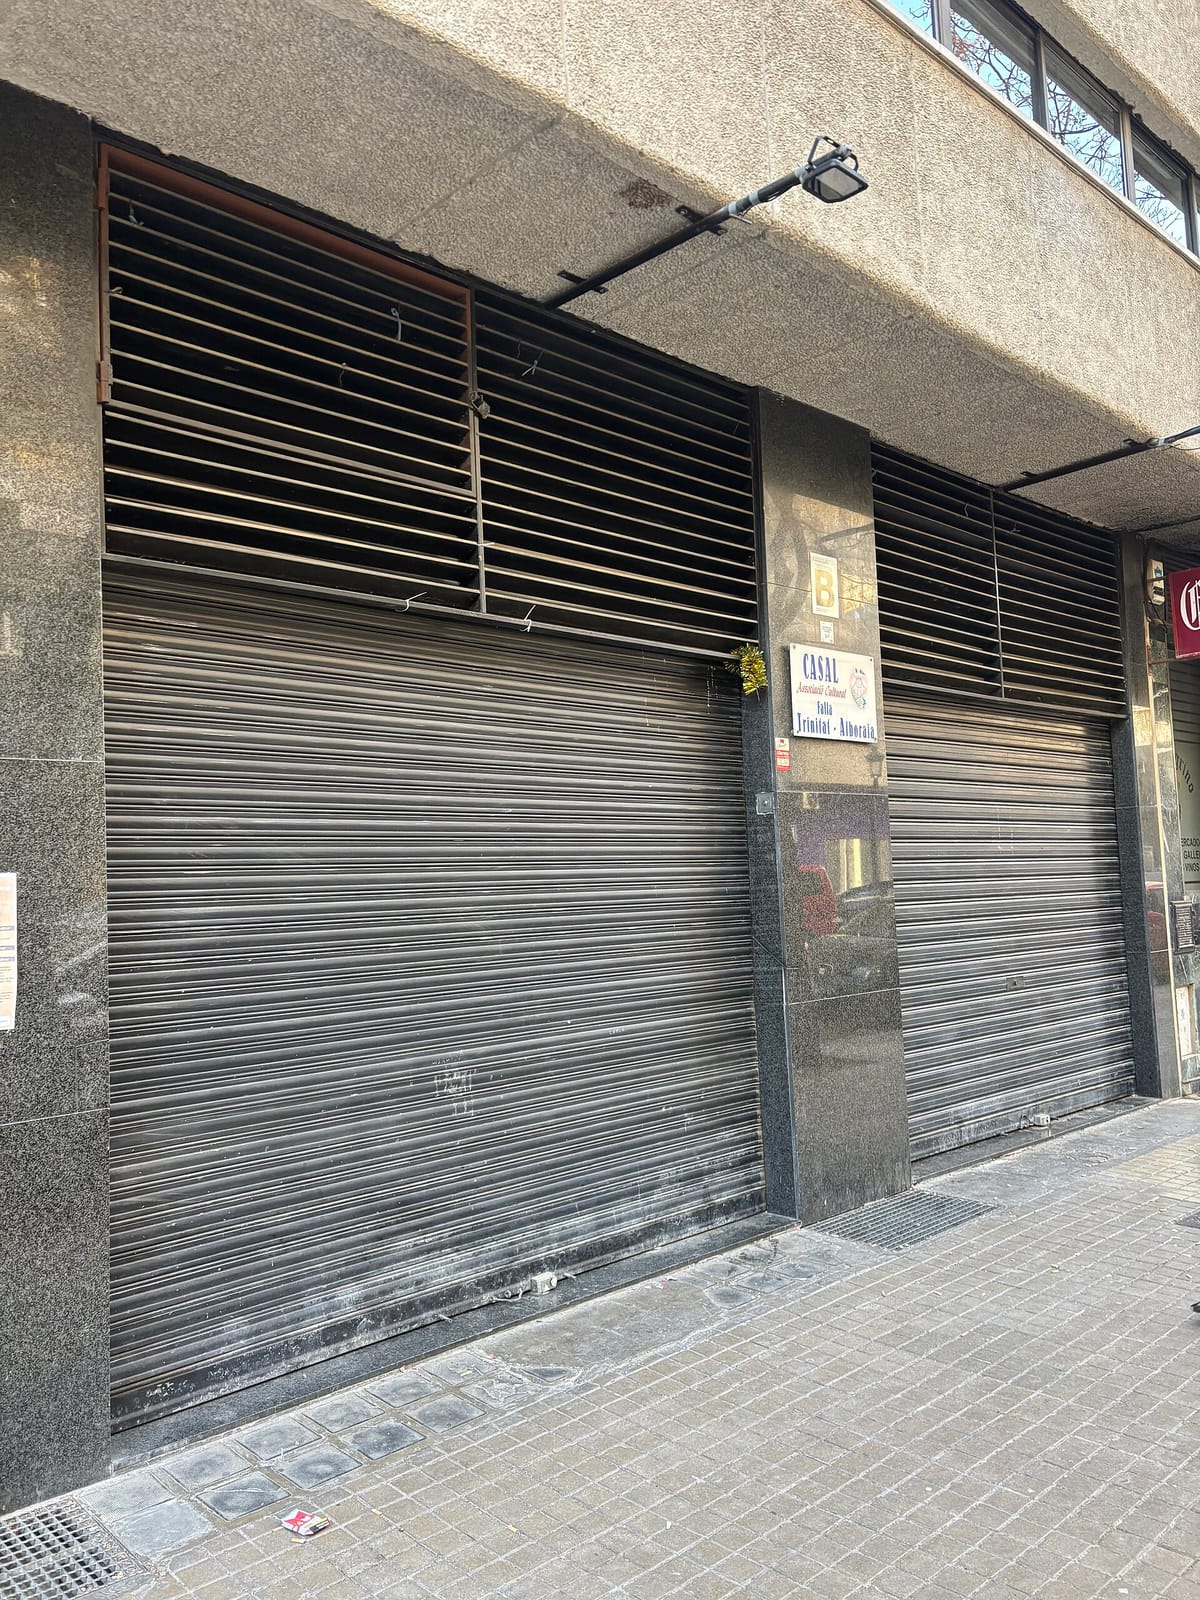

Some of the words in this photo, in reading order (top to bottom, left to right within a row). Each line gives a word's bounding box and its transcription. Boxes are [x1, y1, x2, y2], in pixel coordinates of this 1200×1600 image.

[803, 653, 839, 683] CASAL
[825, 685, 847, 698] Cultural
[817, 700, 832, 715] Falla
[797, 712, 830, 734] Trinitat
[840, 717, 875, 739] Alboraia
